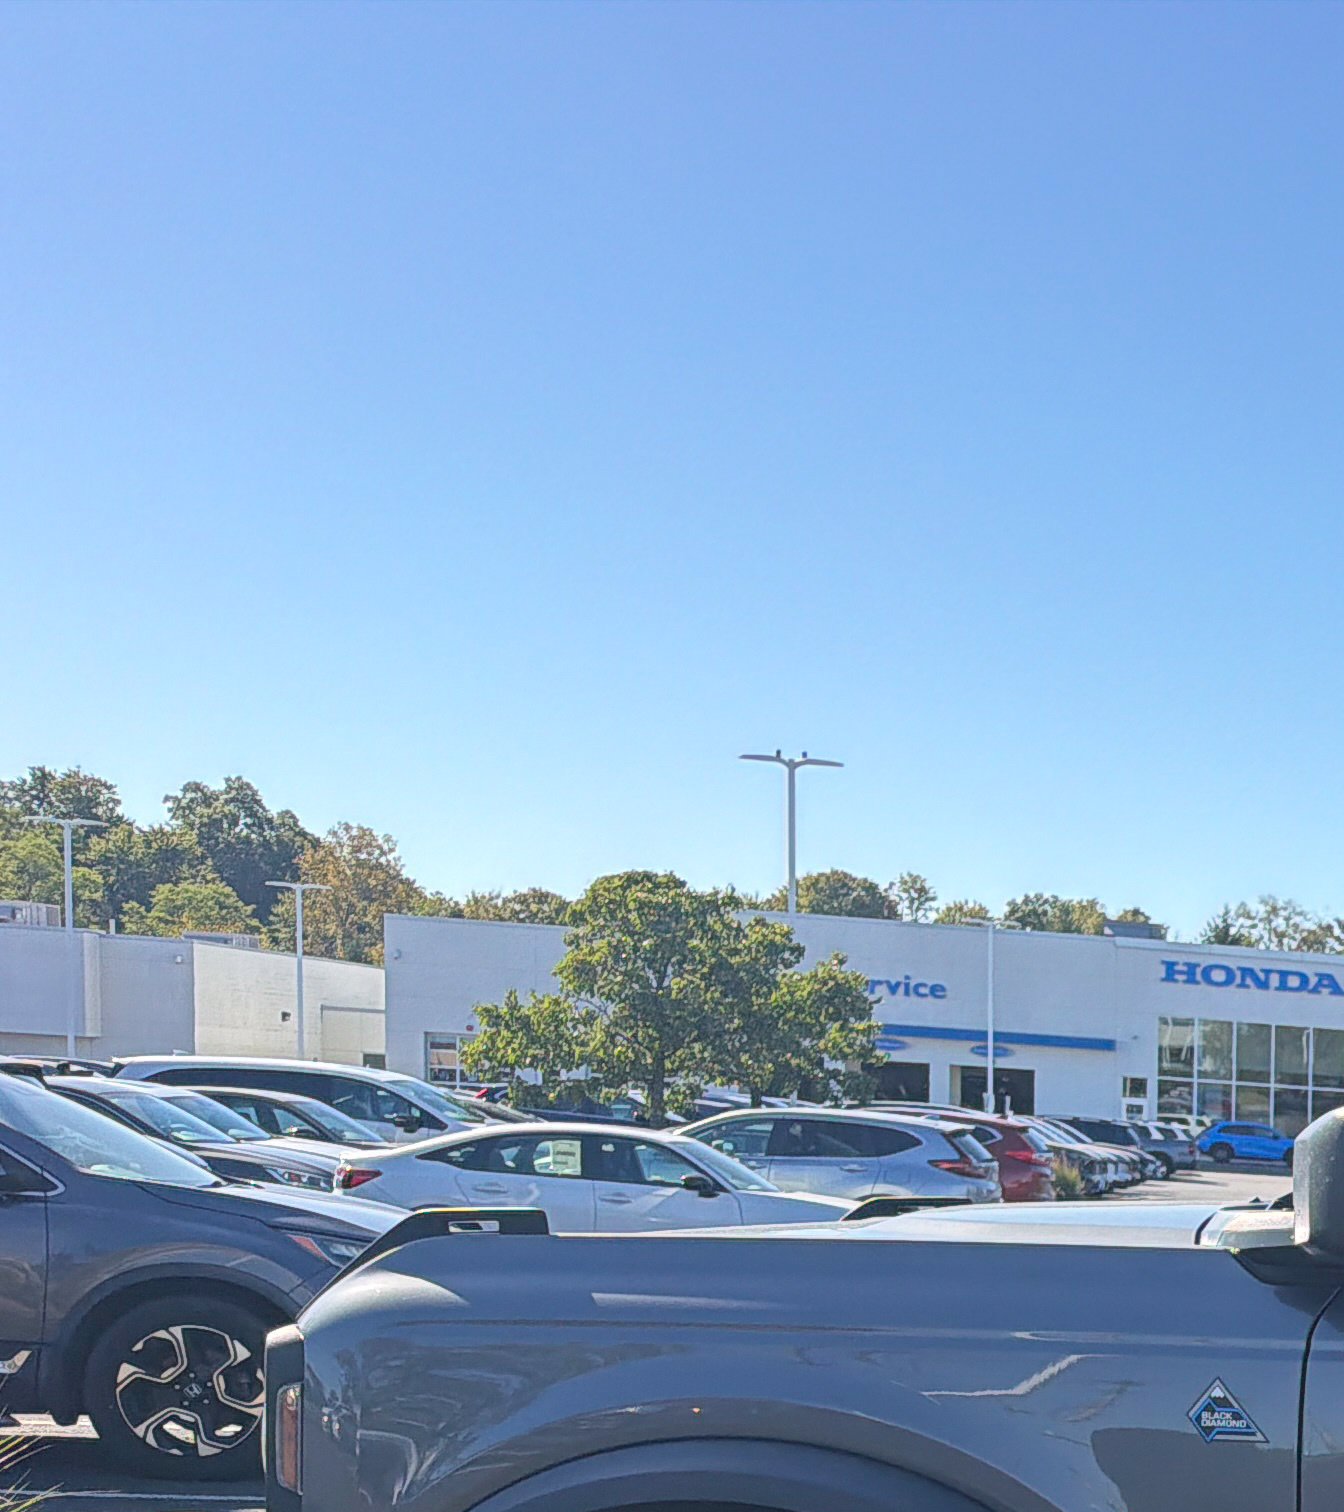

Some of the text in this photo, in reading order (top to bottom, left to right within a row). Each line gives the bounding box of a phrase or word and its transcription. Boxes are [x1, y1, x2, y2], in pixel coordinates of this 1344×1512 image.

[868, 974, 948, 999] rvice
[1201, 1411, 1233, 1420] BLACK
[1201, 1419, 1247, 1428] DIAMOND
